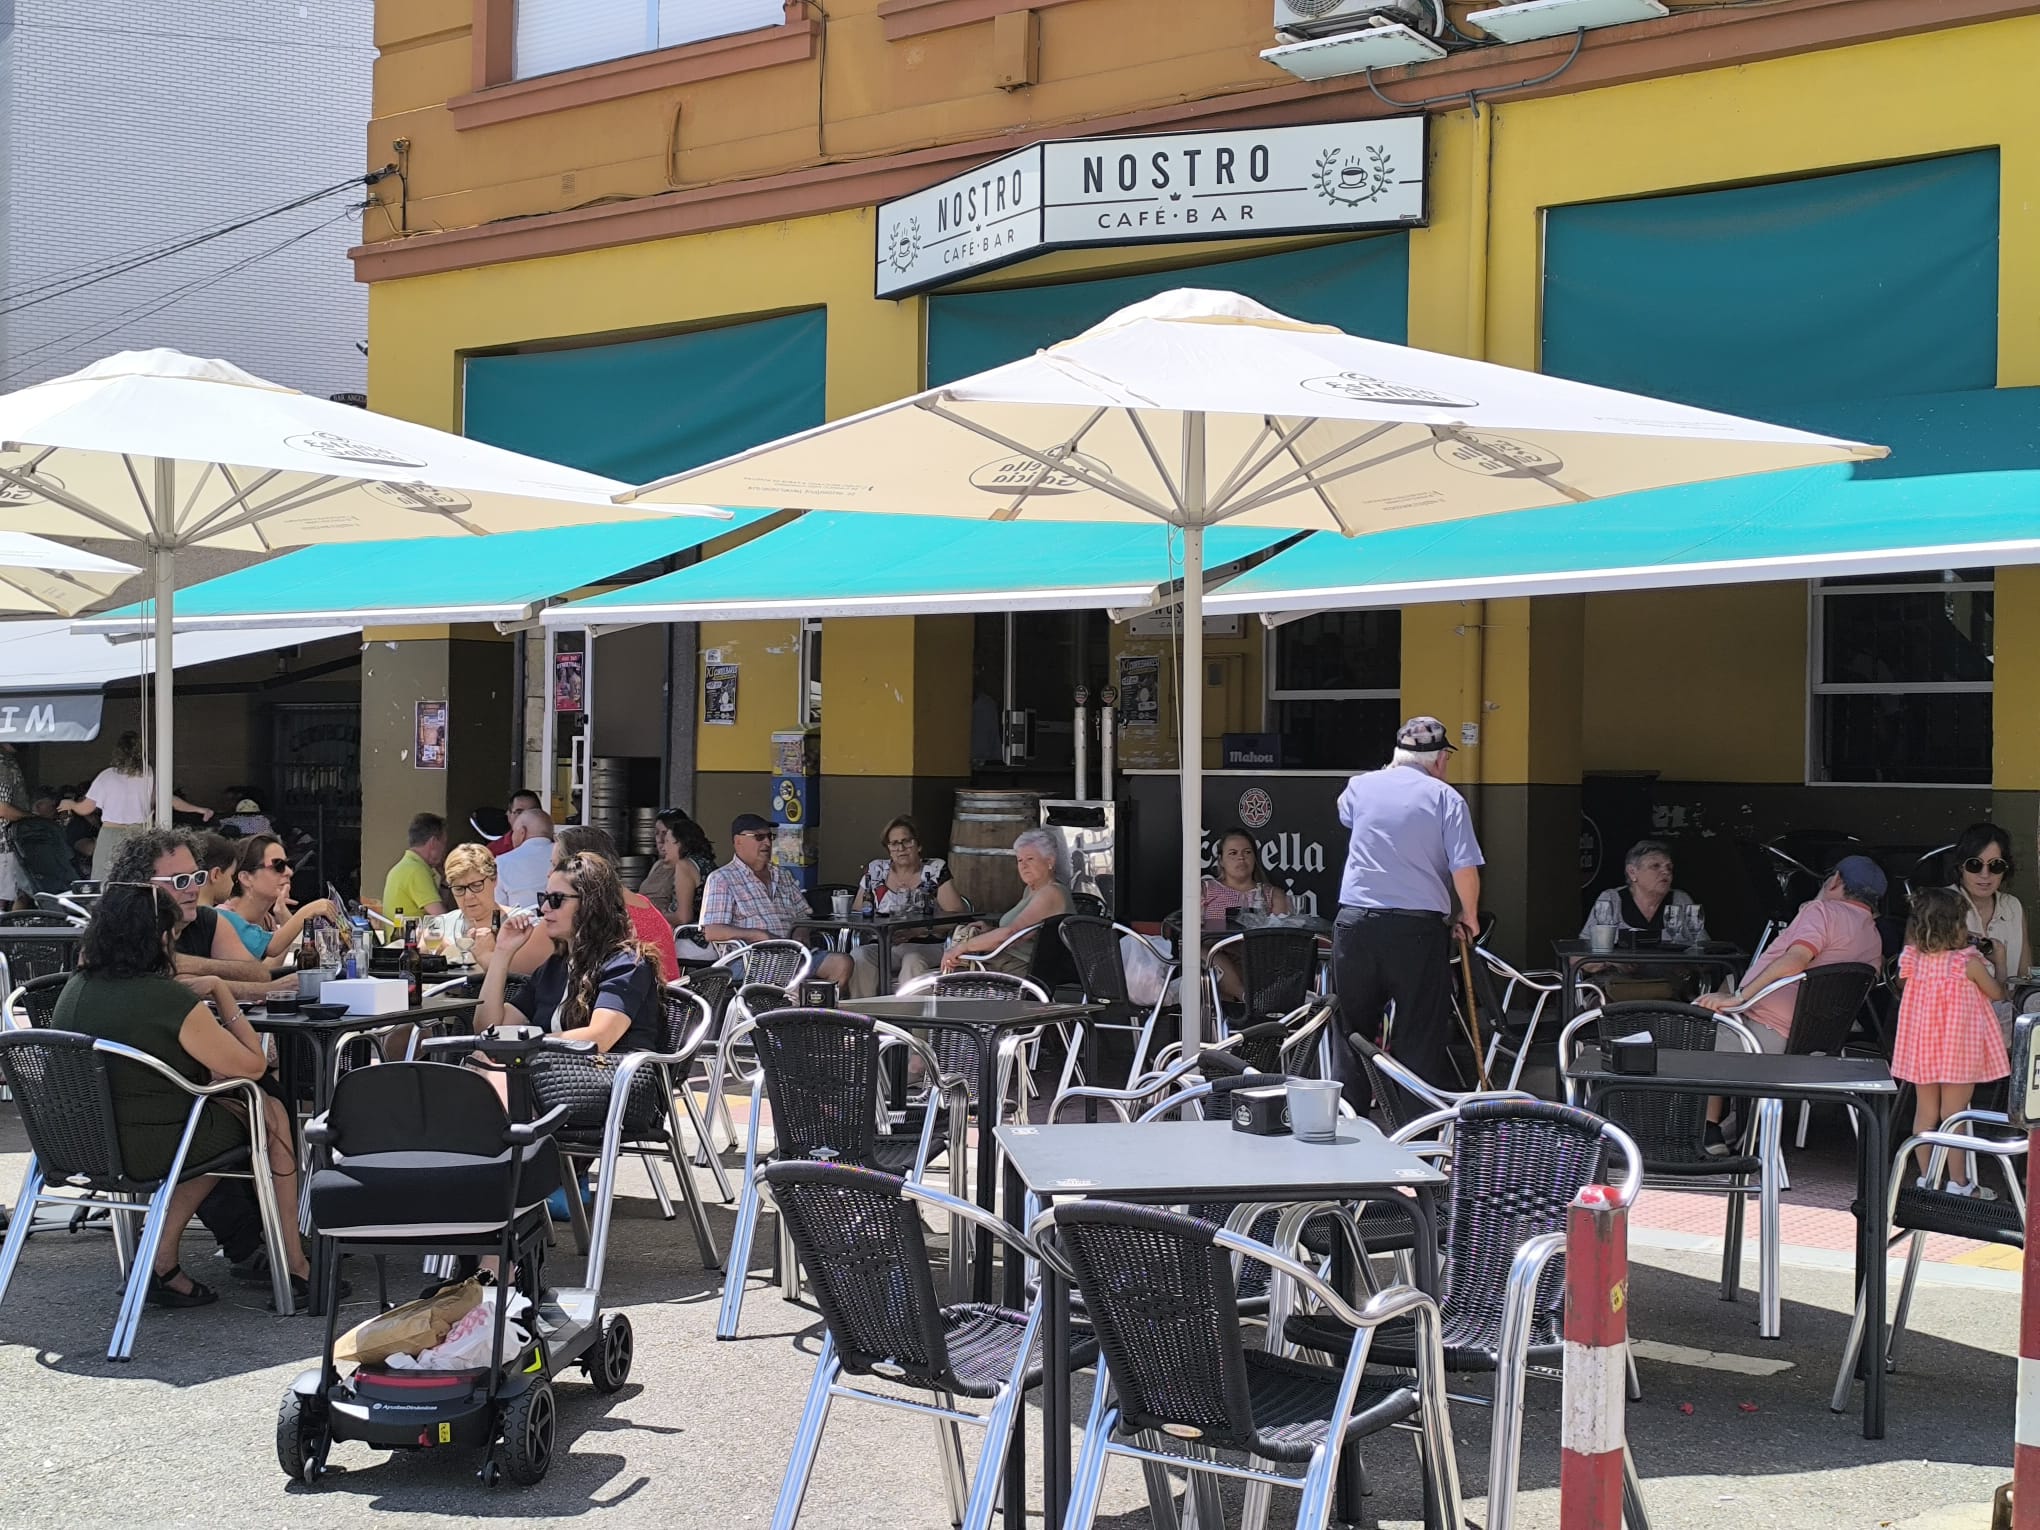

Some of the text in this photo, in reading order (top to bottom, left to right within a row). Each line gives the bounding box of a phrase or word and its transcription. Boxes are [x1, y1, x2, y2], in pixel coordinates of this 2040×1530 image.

[1083, 144, 1271, 194] NOSTRO
[938, 169, 1023, 233] NOSTRO
[1229, 751, 1275, 763] Mahou
